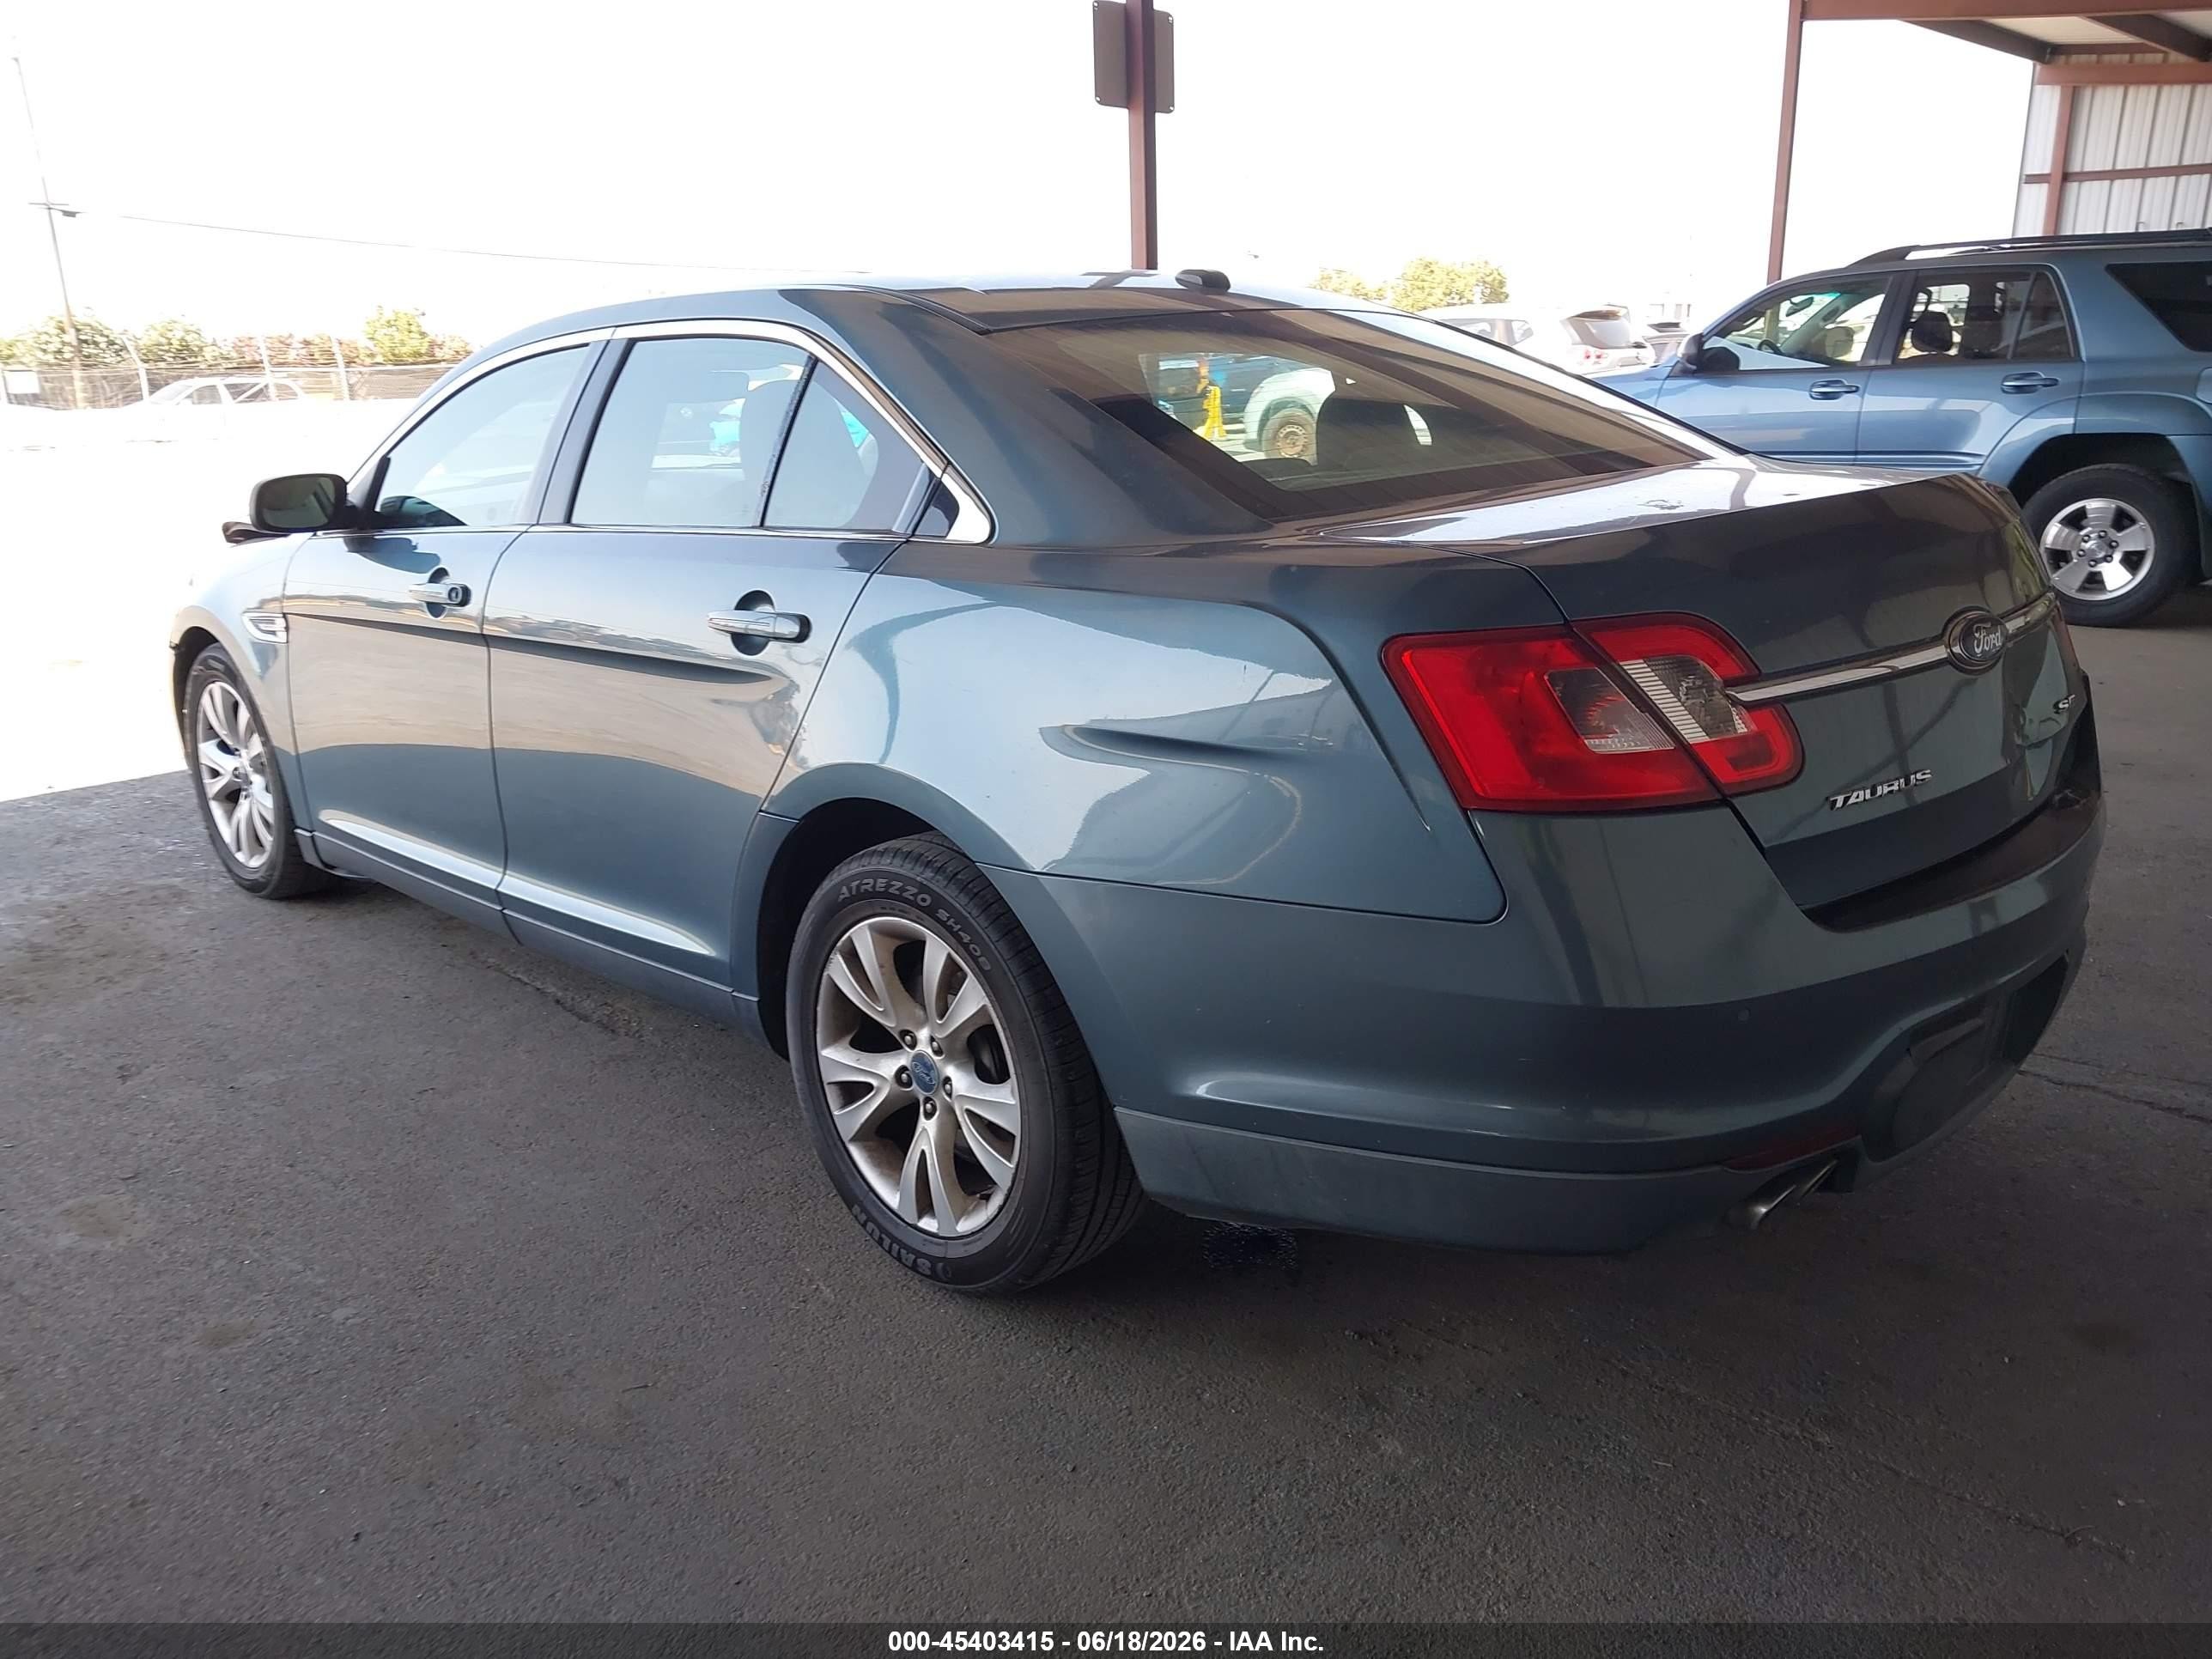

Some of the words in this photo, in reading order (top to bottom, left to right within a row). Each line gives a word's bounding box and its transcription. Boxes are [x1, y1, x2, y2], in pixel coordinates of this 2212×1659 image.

[1973, 622, 2002, 653] Ford
[1829, 769, 1933, 810] TAURUS
[837, 878, 933, 908] ATREZZO
[851, 1203, 933, 1276] SAILUN
